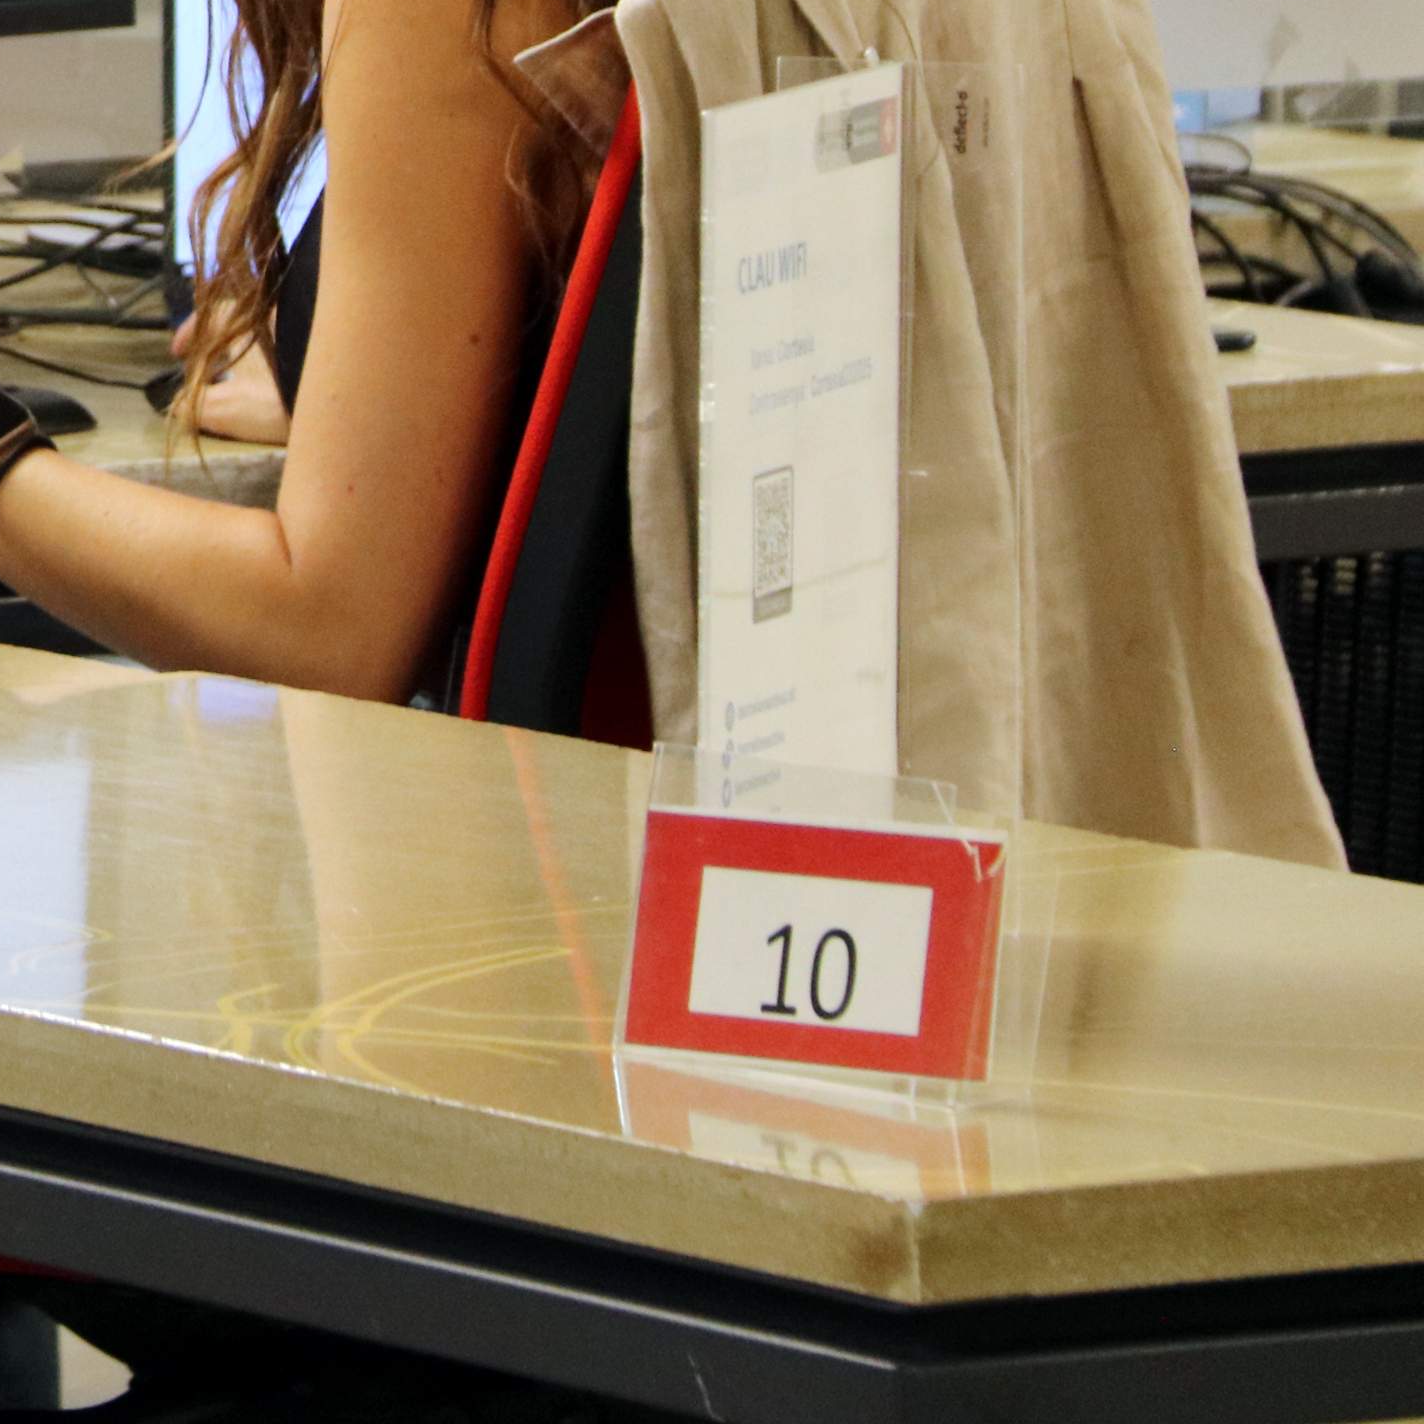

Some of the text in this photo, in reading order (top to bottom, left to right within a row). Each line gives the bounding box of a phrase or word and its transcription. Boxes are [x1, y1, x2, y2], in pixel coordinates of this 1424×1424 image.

[736, 241, 809, 296] CLAU WIFI
[759, 922, 858, 1021] 10
